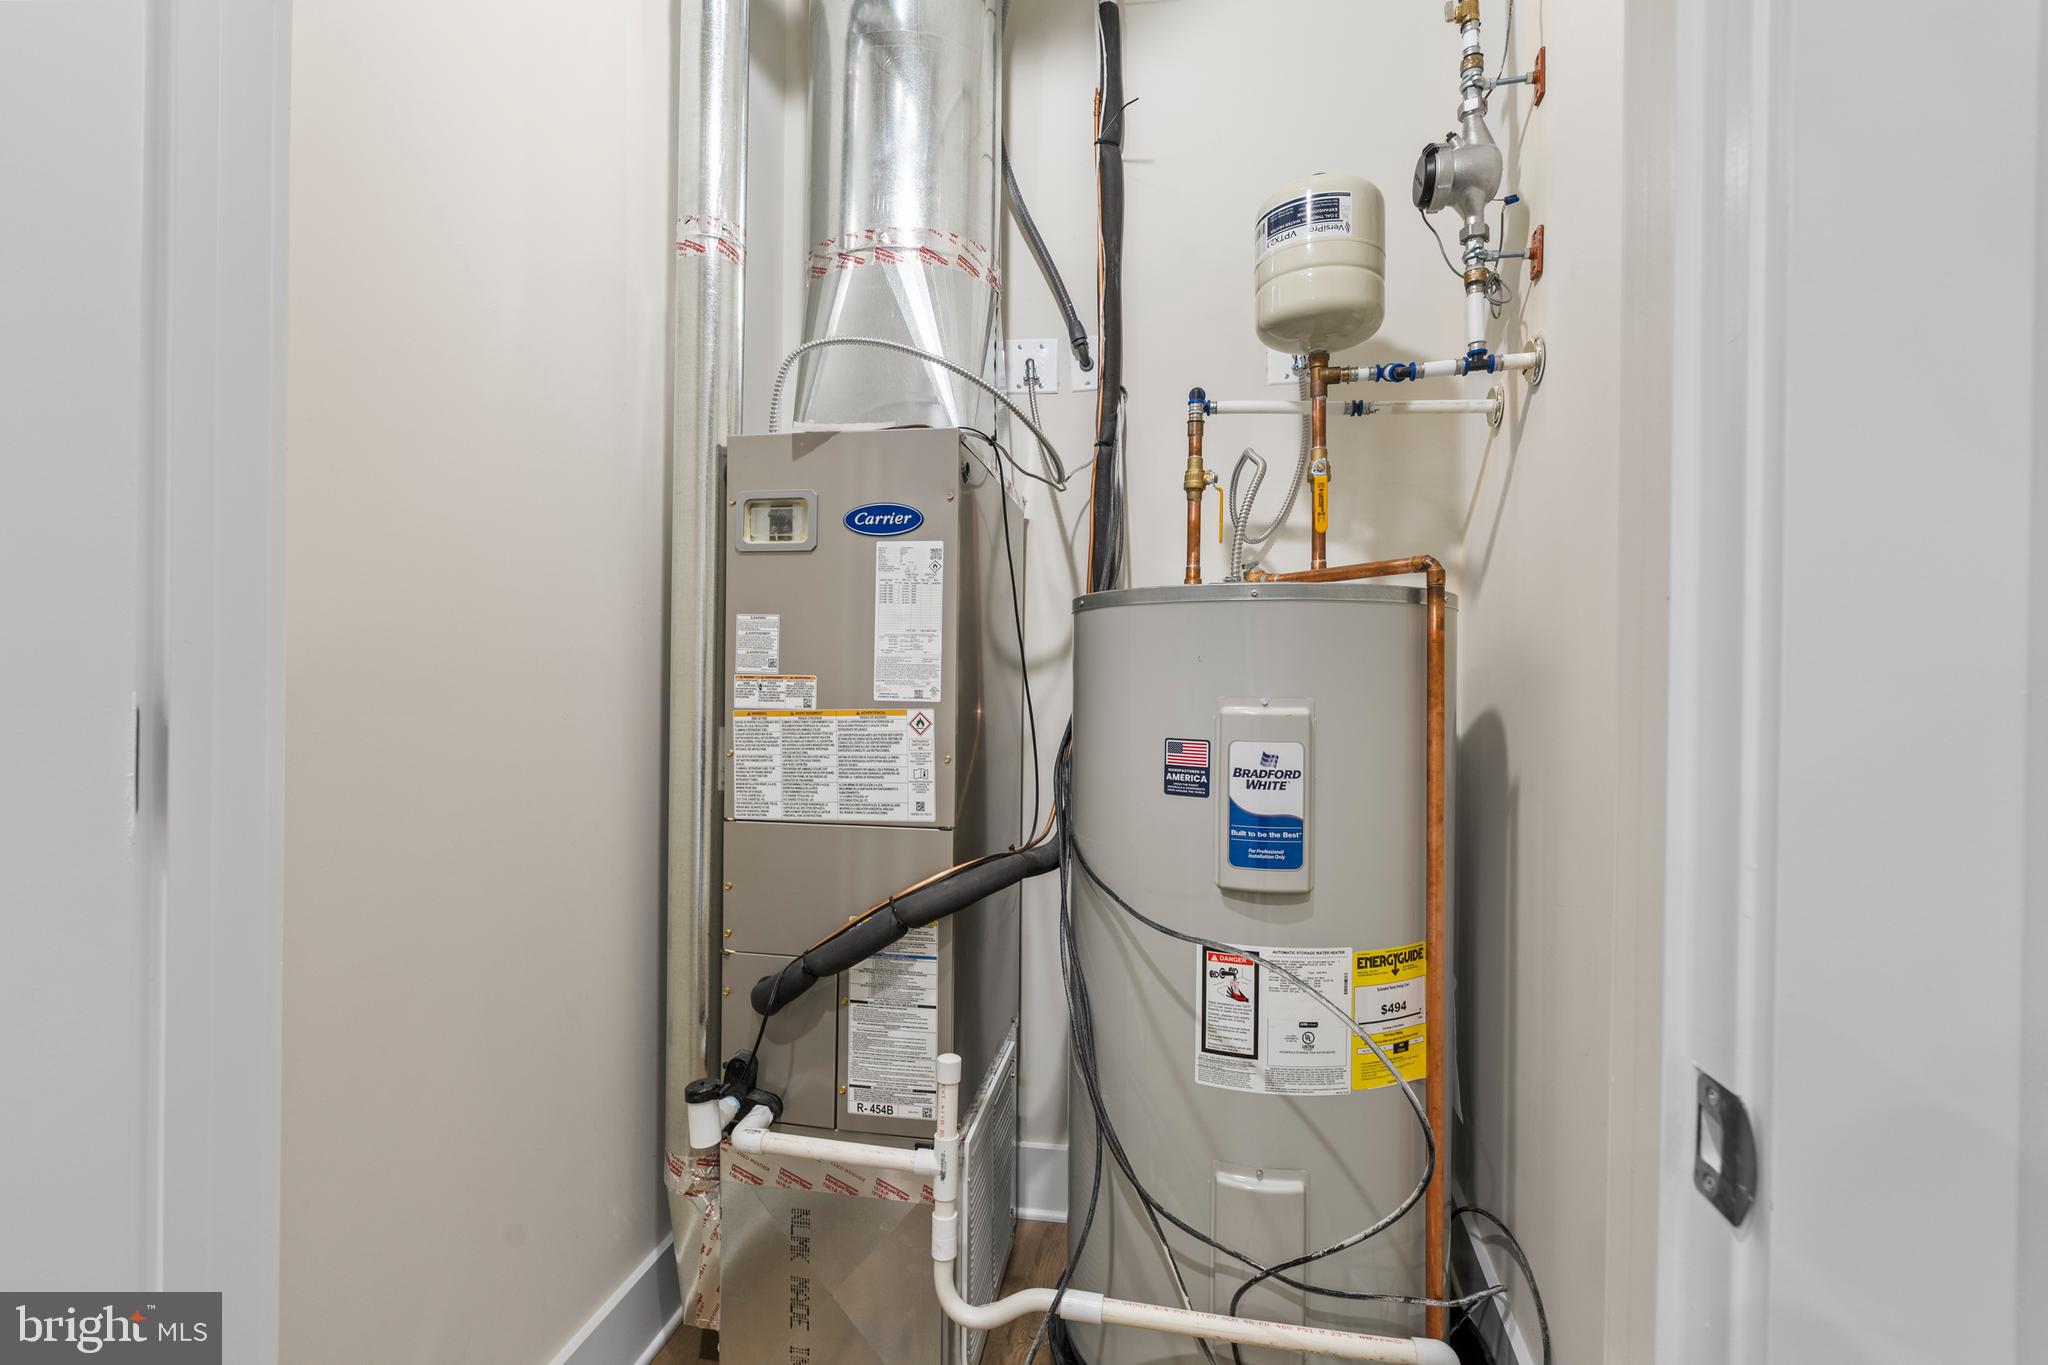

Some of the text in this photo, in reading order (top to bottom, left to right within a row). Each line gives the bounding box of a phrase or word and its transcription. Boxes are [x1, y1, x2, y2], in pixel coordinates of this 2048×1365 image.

[854, 512, 912, 526] Carrier
[1166, 772, 1207, 783] AMERICA
[1232, 767, 1302, 780] BRADFORD
[1246, 780, 1288, 790] WHITE
[1219, 955, 1247, 964] DANGER
[1357, 947, 1424, 970] ENERGYGUIDE
[1381, 1001, 1407, 1015] $494
[870, 1104, 894, 1115] 454B
[790, 1275, 810, 1331] MADE
